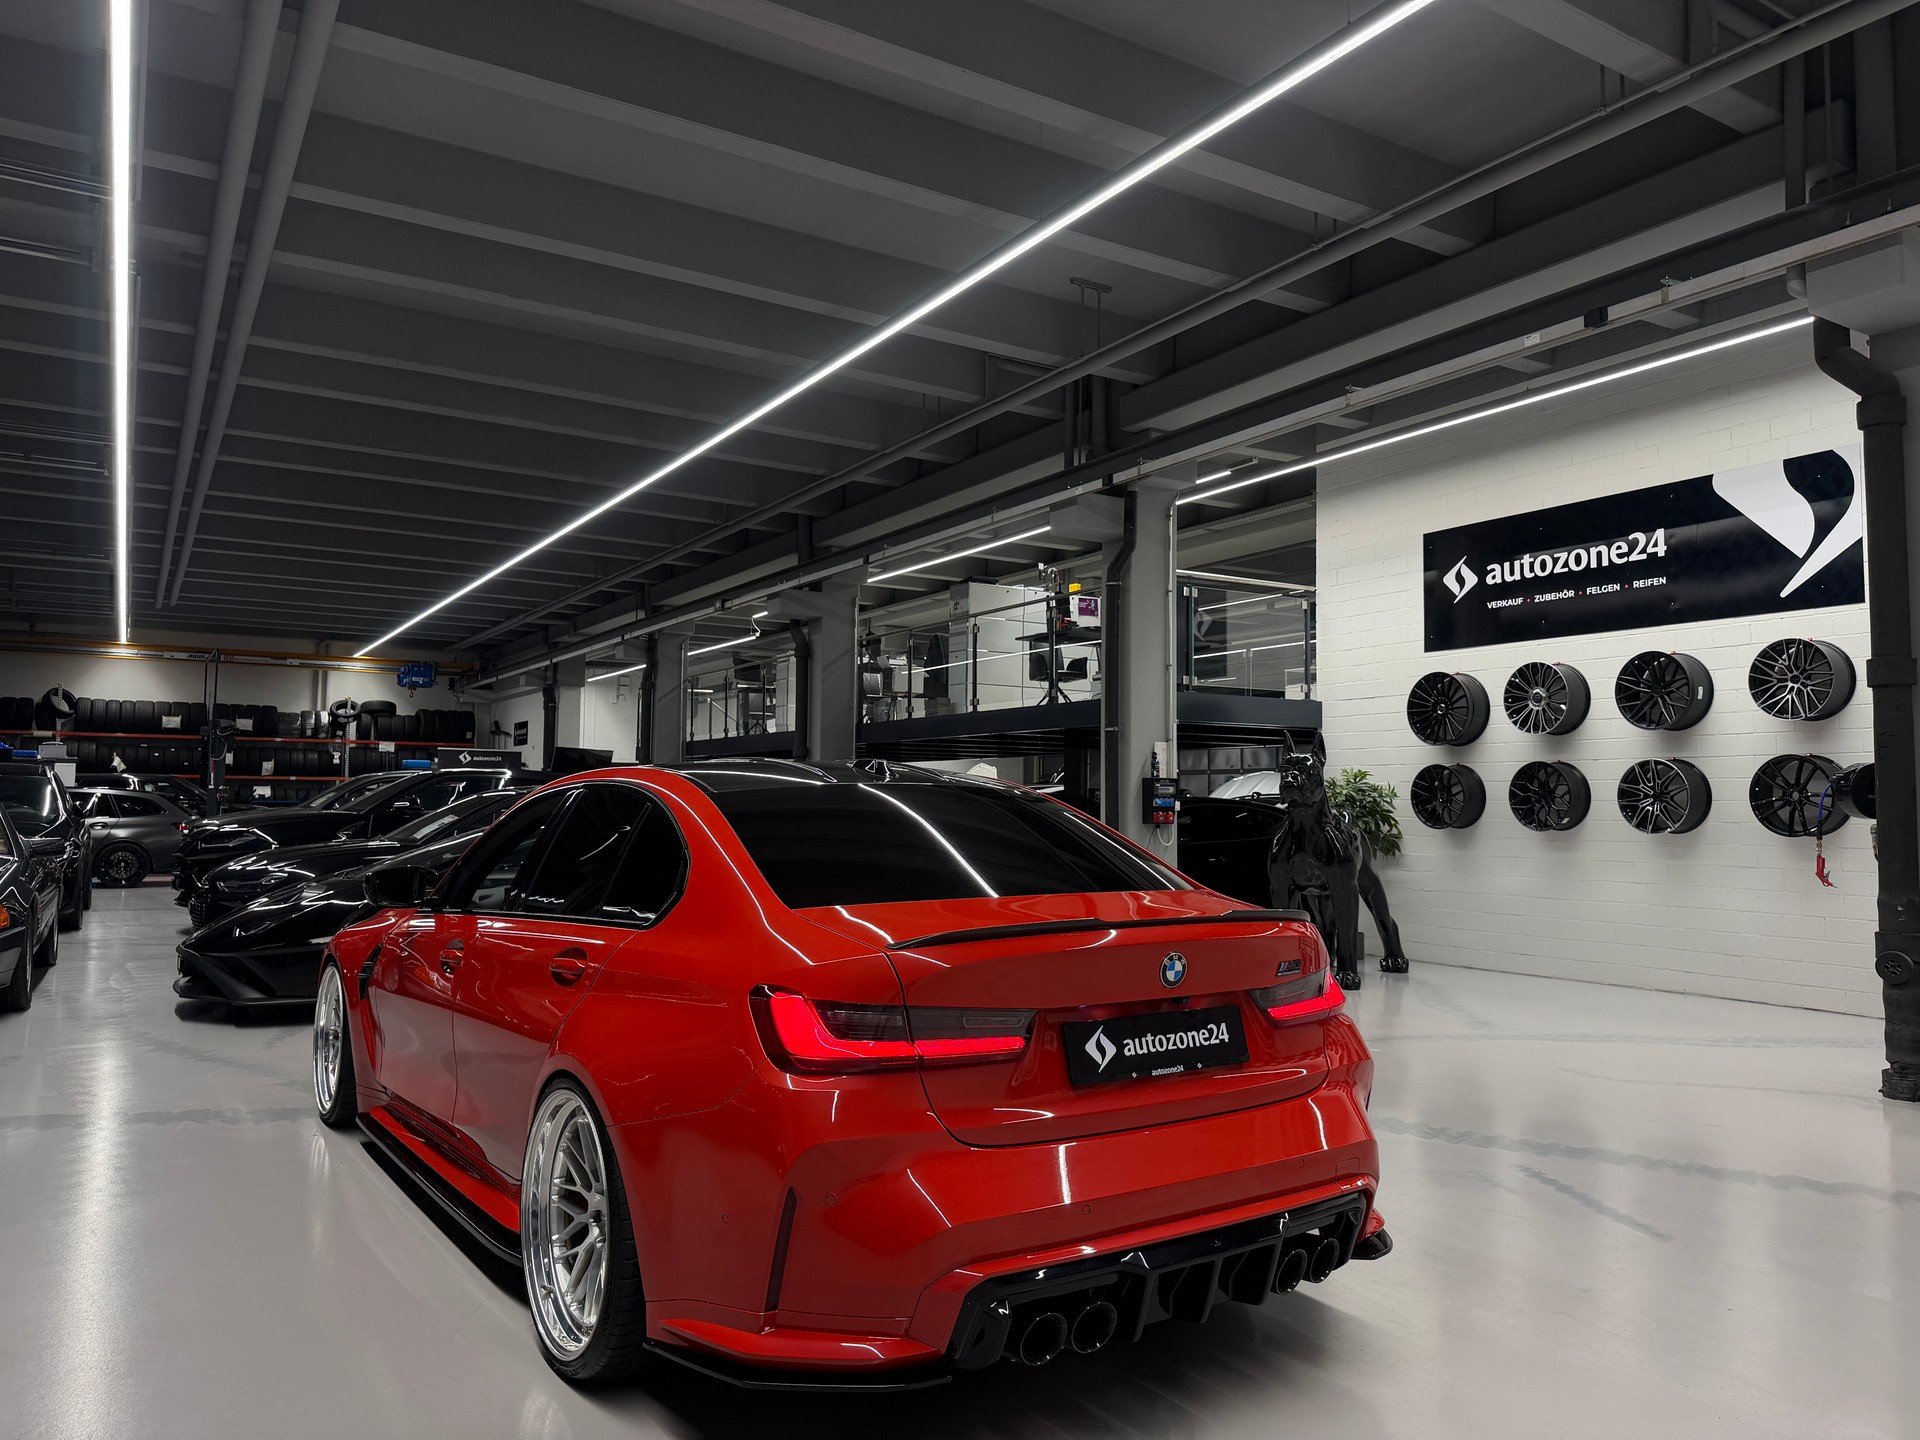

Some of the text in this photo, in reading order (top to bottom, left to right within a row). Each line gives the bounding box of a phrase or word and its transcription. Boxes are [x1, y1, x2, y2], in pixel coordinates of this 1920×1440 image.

[1485, 528, 1668, 585] autozone24
[1486, 576, 1667, 609] VERKAUF ZUBEHÖR FELGEN REIFEN
[1164, 954, 1187, 966] BMW
[1123, 1022, 1230, 1057] autozone24
[1151, 1064, 1184, 1076] autozone24
